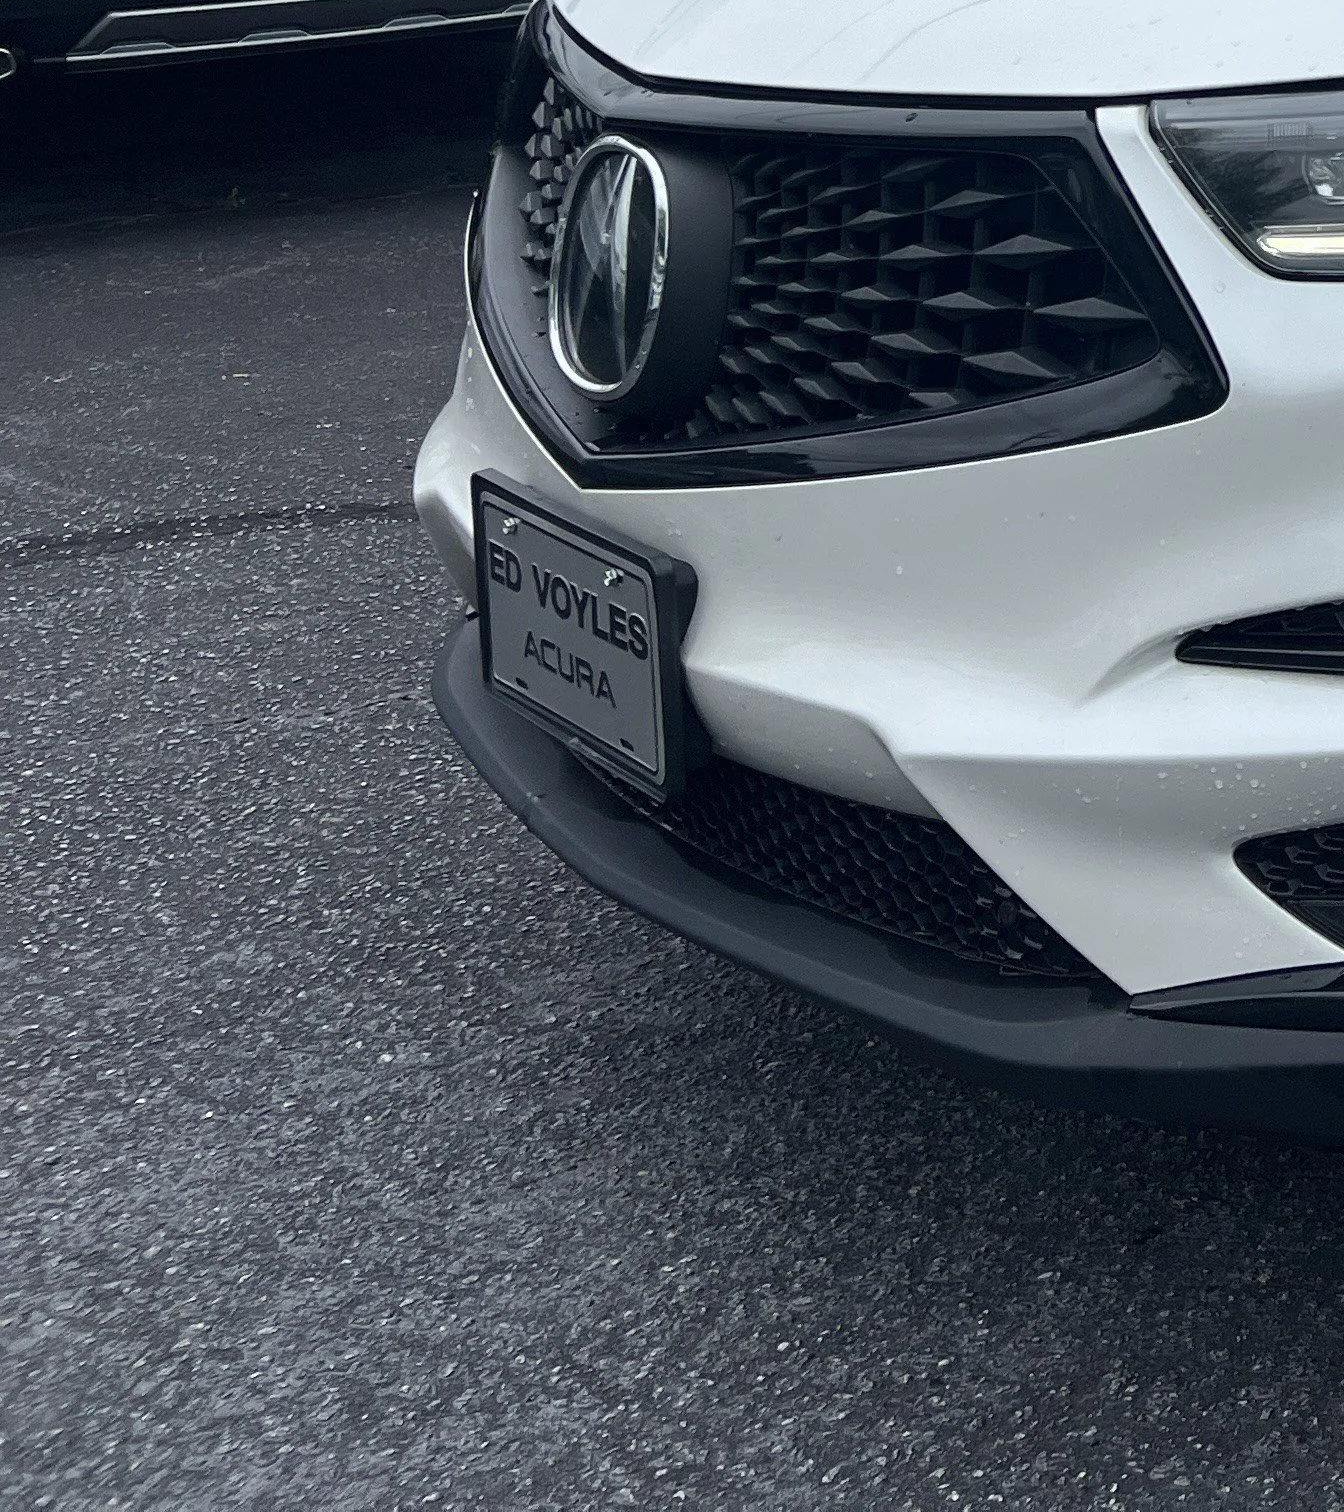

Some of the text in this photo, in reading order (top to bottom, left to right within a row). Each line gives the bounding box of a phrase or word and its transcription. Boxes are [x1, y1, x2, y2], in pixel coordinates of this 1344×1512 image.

[488, 538, 649, 661] ED VOYLES
[523, 630, 617, 709] ACURA
